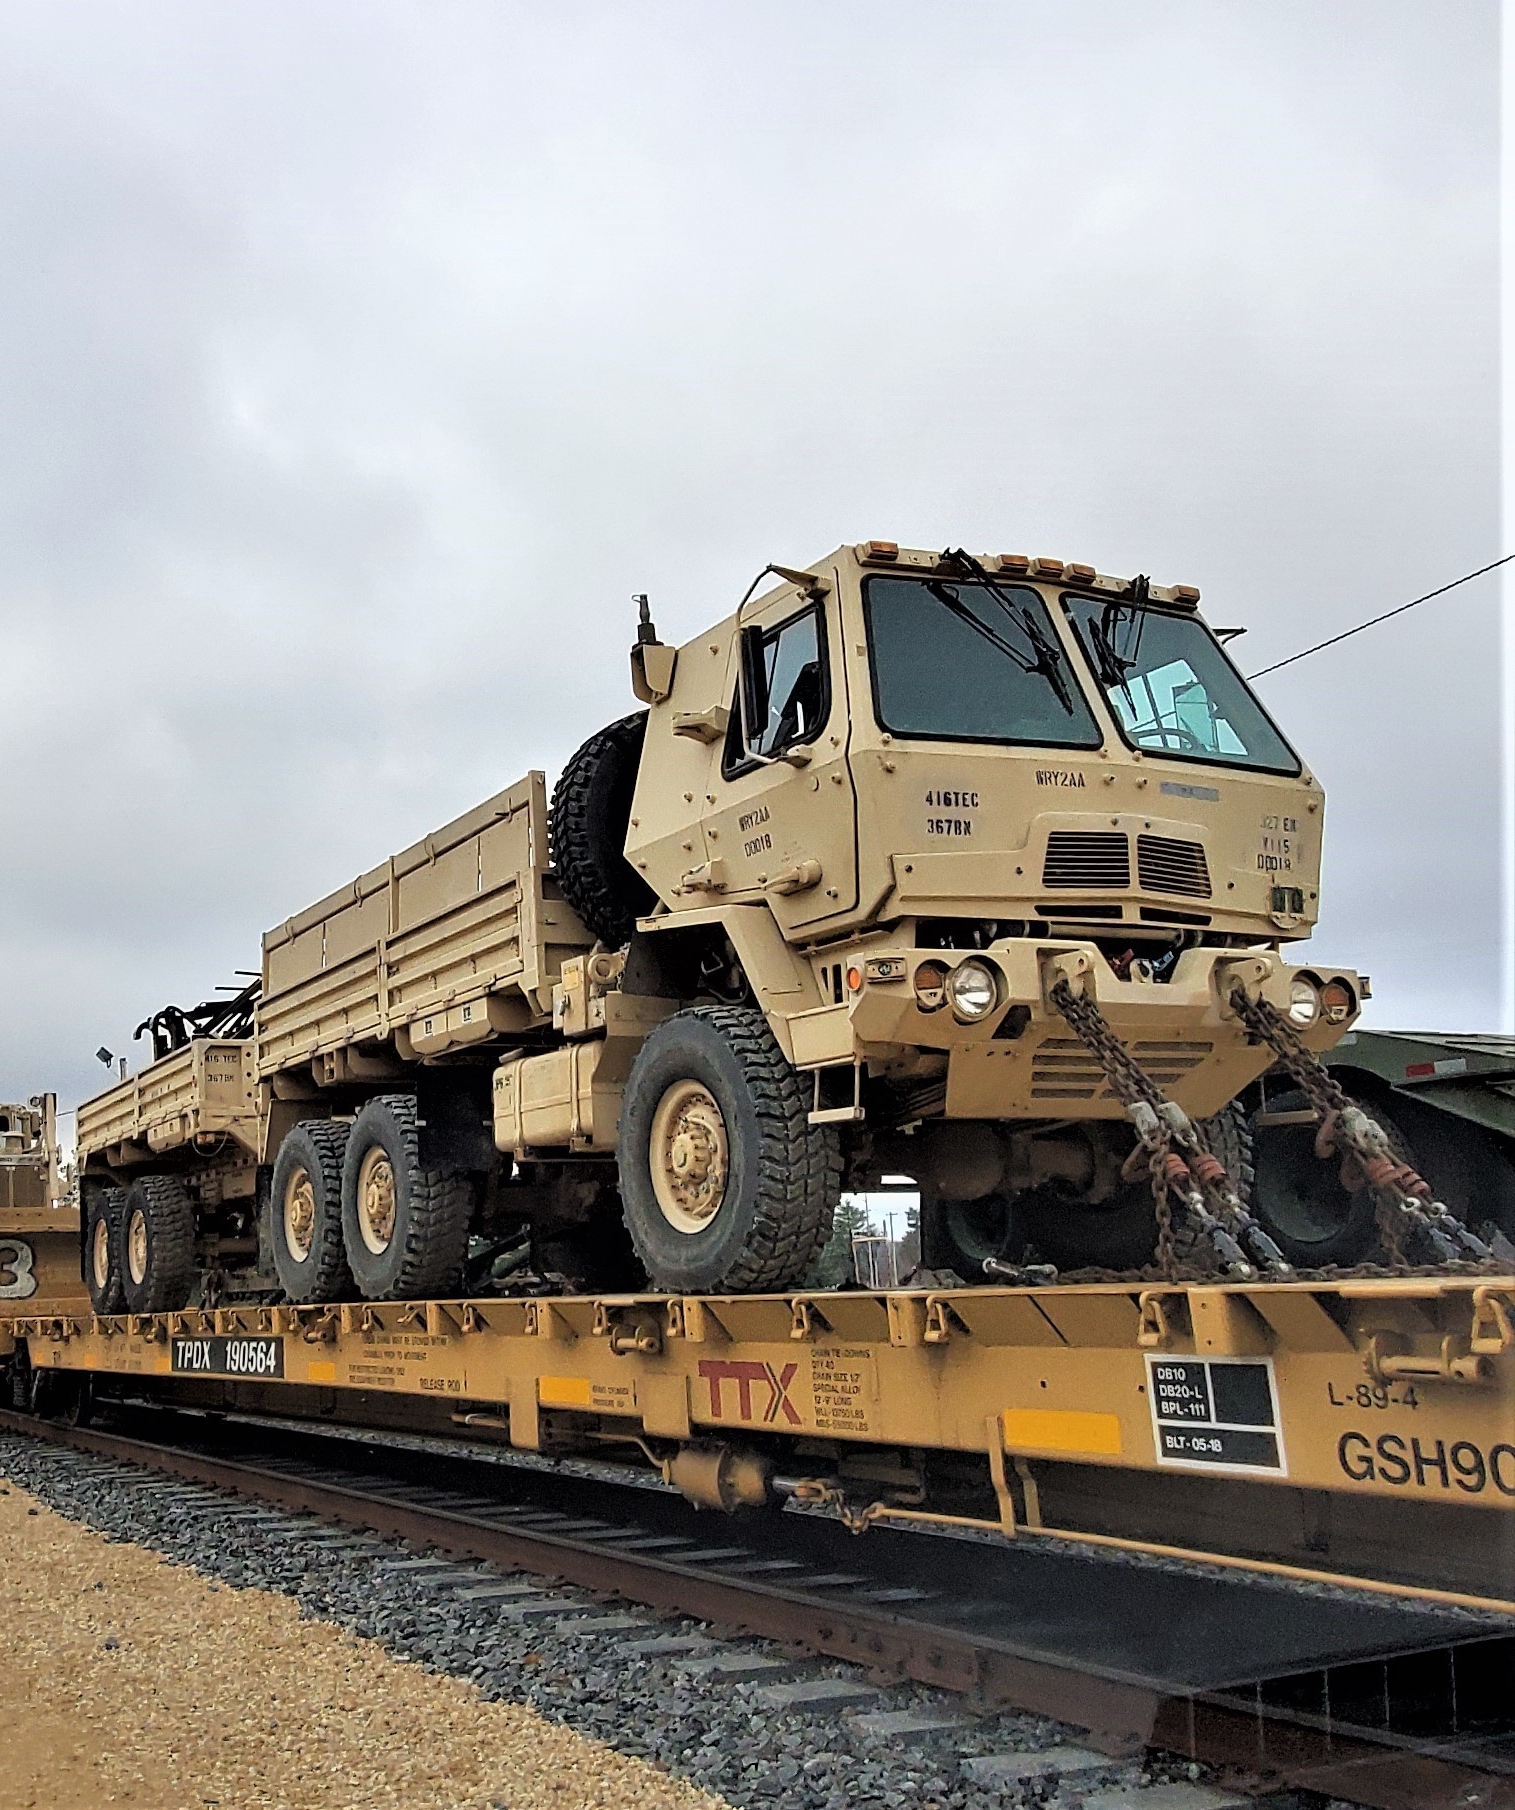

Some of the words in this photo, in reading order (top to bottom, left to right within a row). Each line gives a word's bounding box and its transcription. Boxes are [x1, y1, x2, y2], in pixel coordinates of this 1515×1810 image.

[925, 790, 979, 808] 416TEC
[927, 819, 972, 836] 367BN
[176, 1340, 211, 1370] TPDX
[225, 1340, 277, 1374] 190564
[1156, 1367, 1186, 1381] DB10
[698, 1359, 803, 1426] TTX
[1158, 1384, 1203, 1399] DB20-L
[1327, 1381, 1420, 1411] L-89-4
[1161, 1401, 1206, 1417] BPL-111
